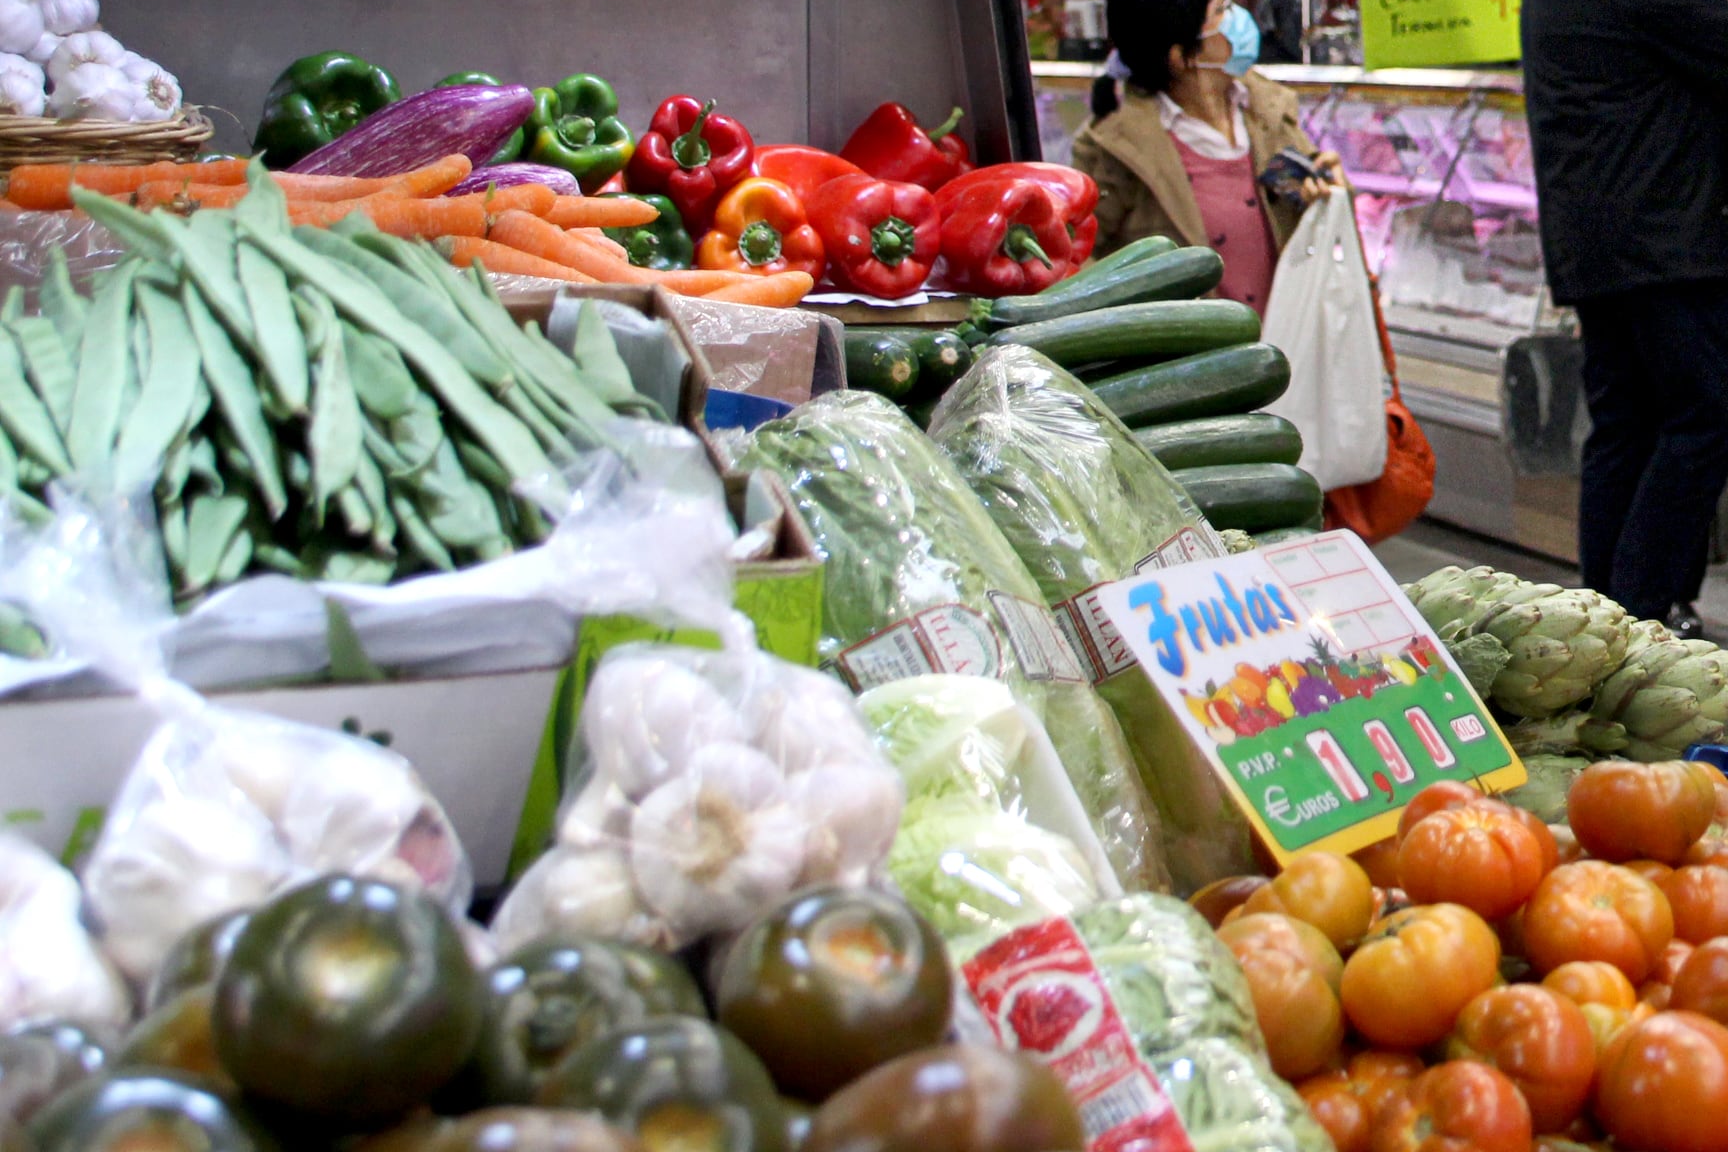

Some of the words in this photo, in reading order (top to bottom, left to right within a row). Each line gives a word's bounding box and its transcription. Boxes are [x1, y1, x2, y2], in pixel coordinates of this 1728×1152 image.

[1128, 570, 1298, 678] Frutas
[1453, 717, 1482, 739] KILO
[1237, 751, 1281, 779] P.V.P.
